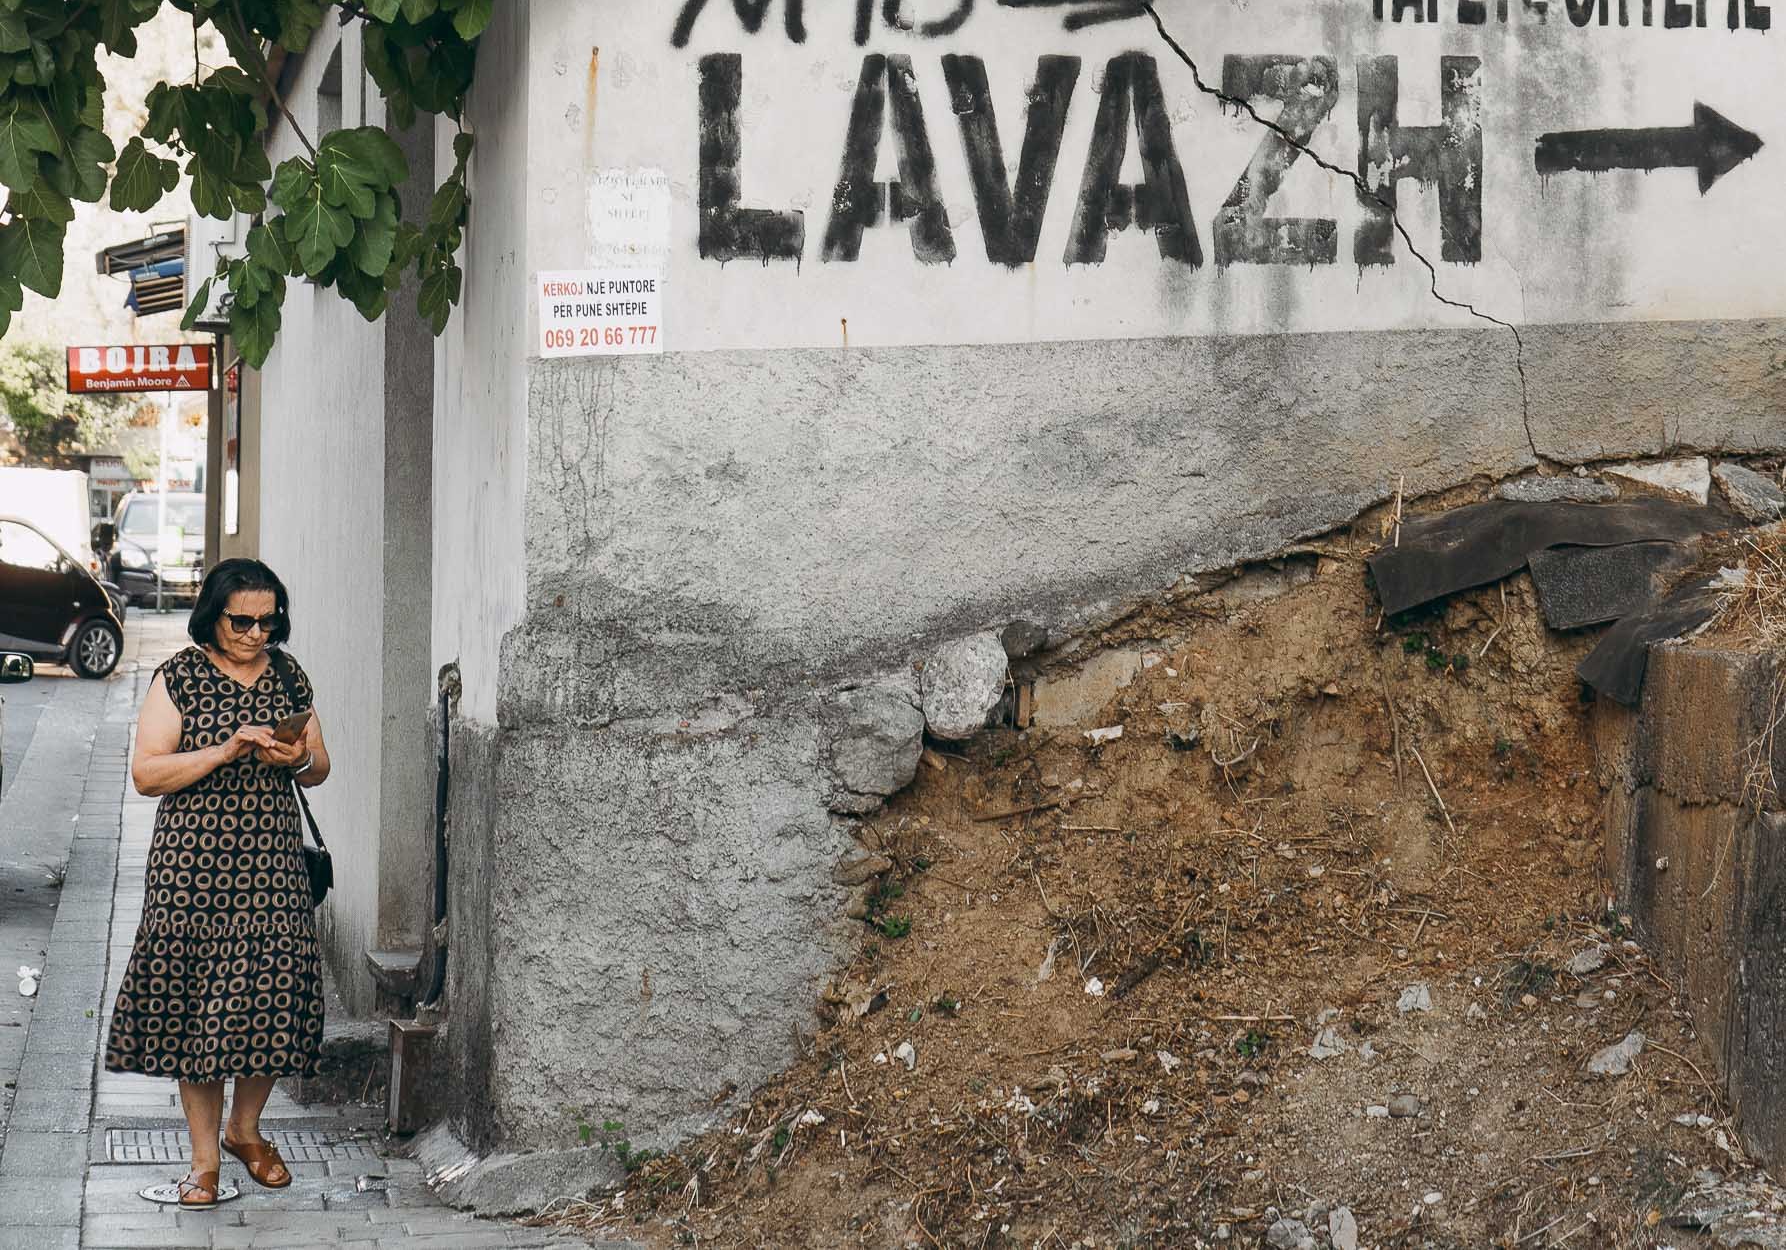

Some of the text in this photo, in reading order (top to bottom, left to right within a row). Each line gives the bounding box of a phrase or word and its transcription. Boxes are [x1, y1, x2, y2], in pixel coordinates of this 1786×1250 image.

[696, 51, 1483, 268] LAVAZH
[608, 279, 656, 294] PUNTORE
[545, 325, 657, 348] 069 20 66 777
[79, 346, 197, 374] BOJRA
[86, 377, 172, 389] Benjamin Moore
